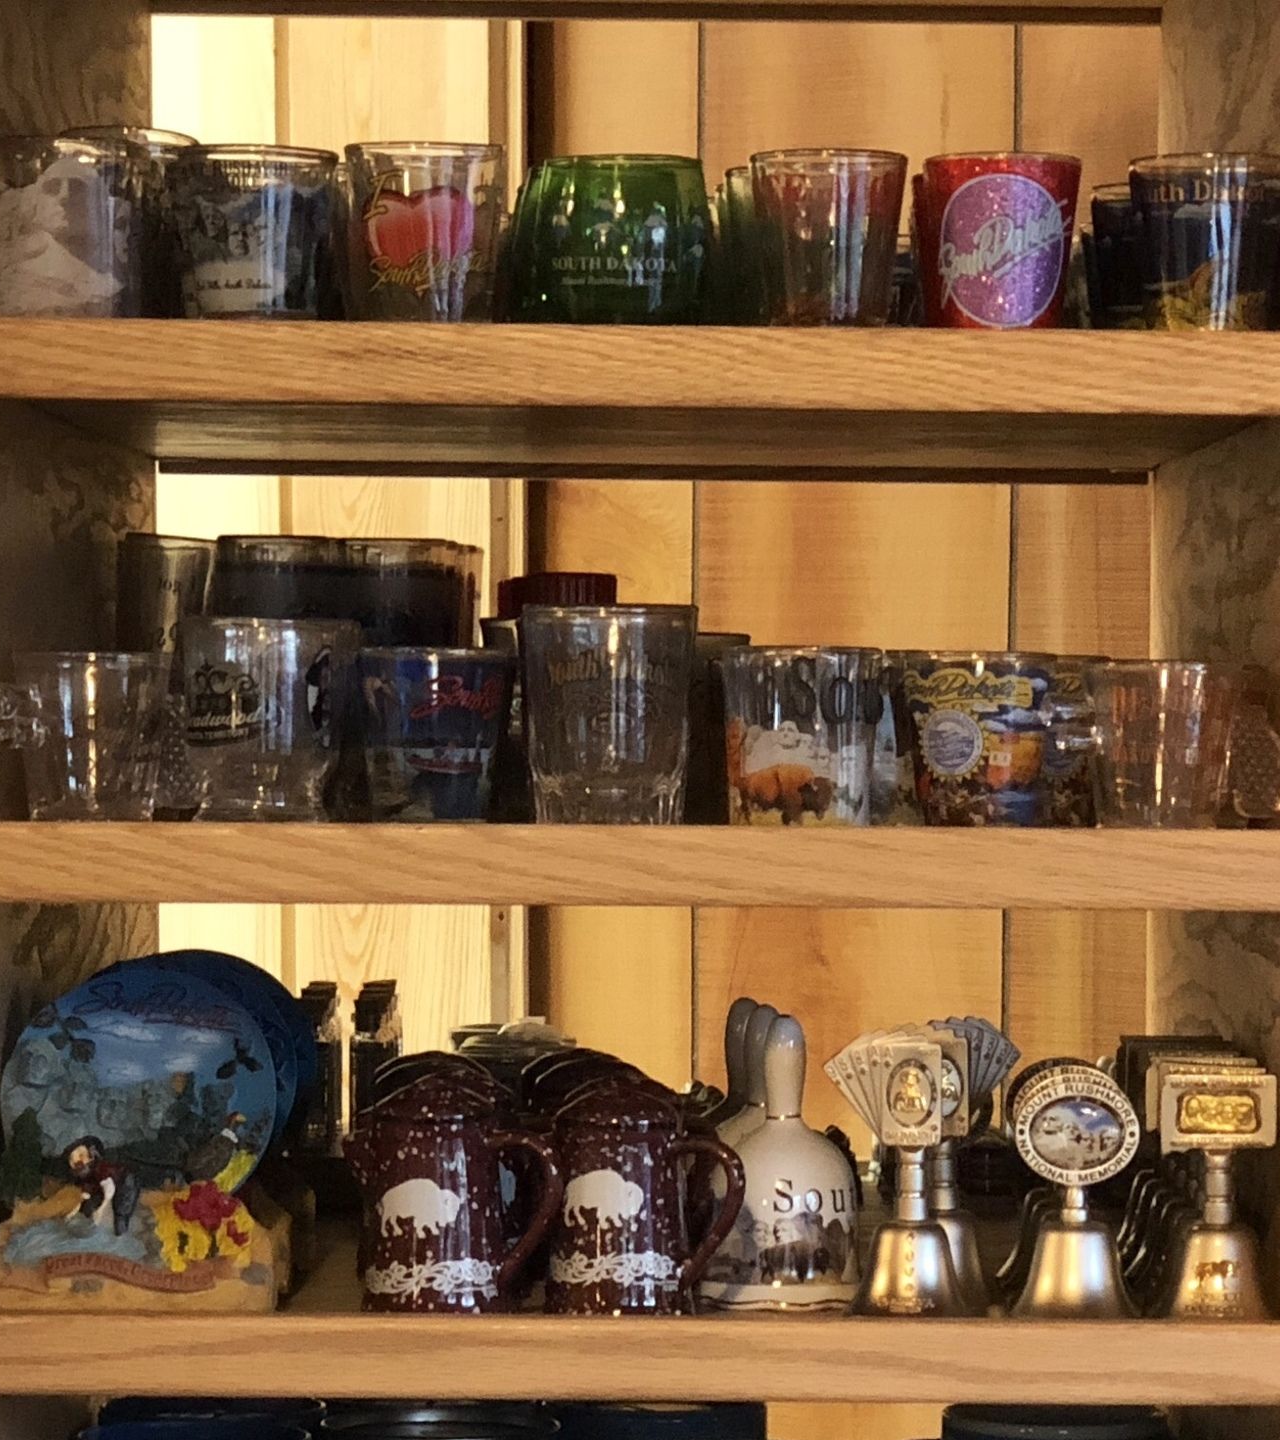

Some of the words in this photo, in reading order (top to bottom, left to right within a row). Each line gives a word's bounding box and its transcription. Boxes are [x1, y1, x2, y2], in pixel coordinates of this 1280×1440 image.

[552, 256, 601, 272] SOUTH
[607, 256, 677, 272] DAKOTA
[1020, 1088, 1059, 1126] MOUNT
[1064, 1084, 1137, 1128] RUSHMORE
[1019, 1140, 1073, 1183] NATIONAL
[1078, 1142, 1137, 1182] MEMORIAL
